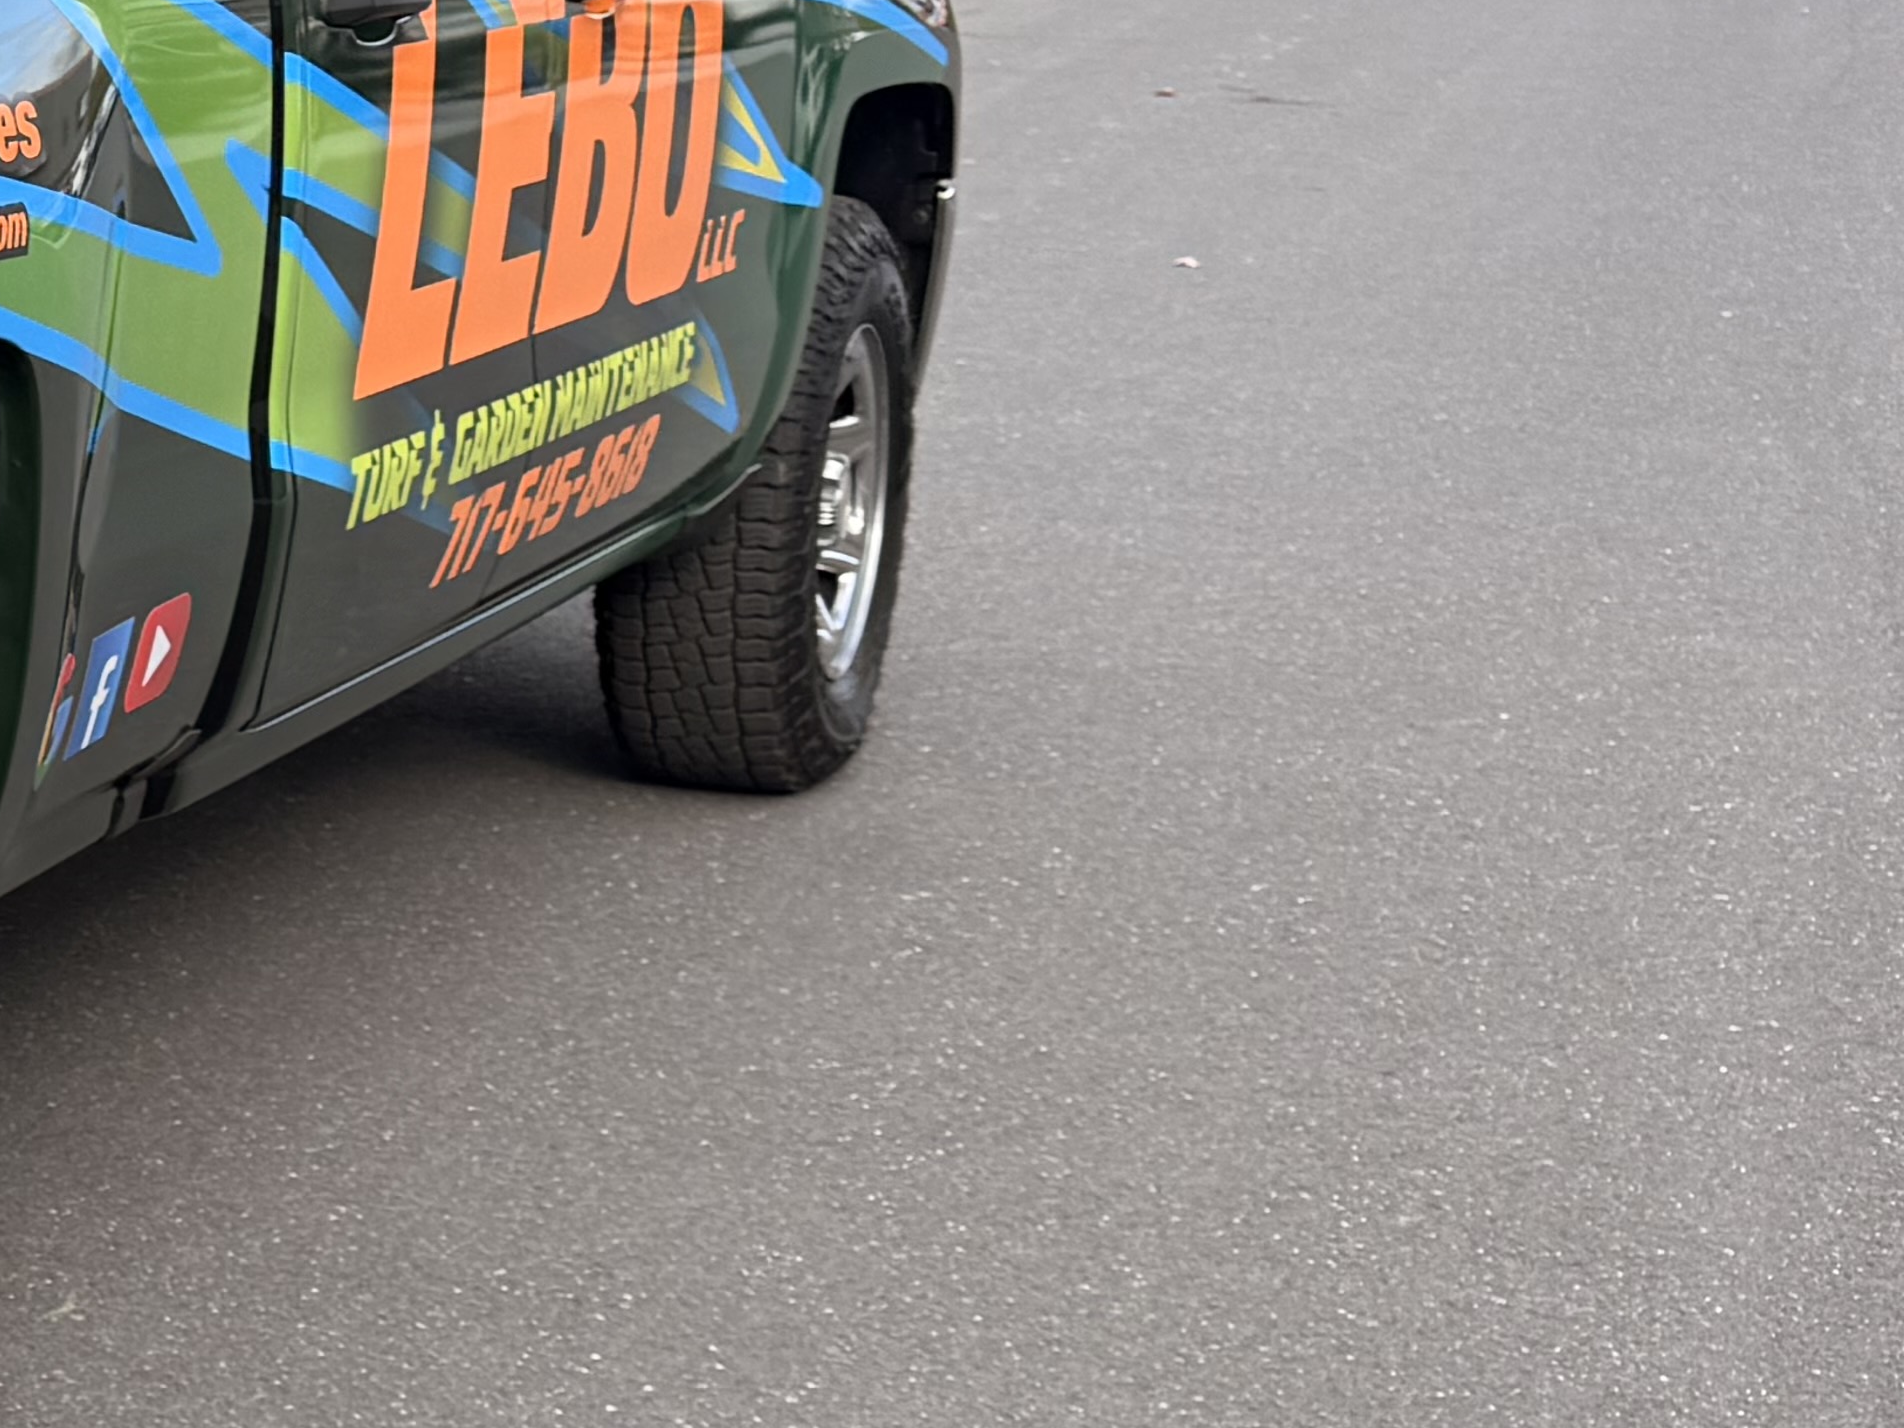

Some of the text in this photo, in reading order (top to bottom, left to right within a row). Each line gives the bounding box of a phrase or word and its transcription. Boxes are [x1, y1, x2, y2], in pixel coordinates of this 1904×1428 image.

[696, 209, 745, 283] LLC
[346, 430, 426, 531] TURF
[448, 380, 552, 485] GARDEN
[548, 321, 696, 443] MAINTENANCE
[429, 414, 661, 590] 717-645-8618
